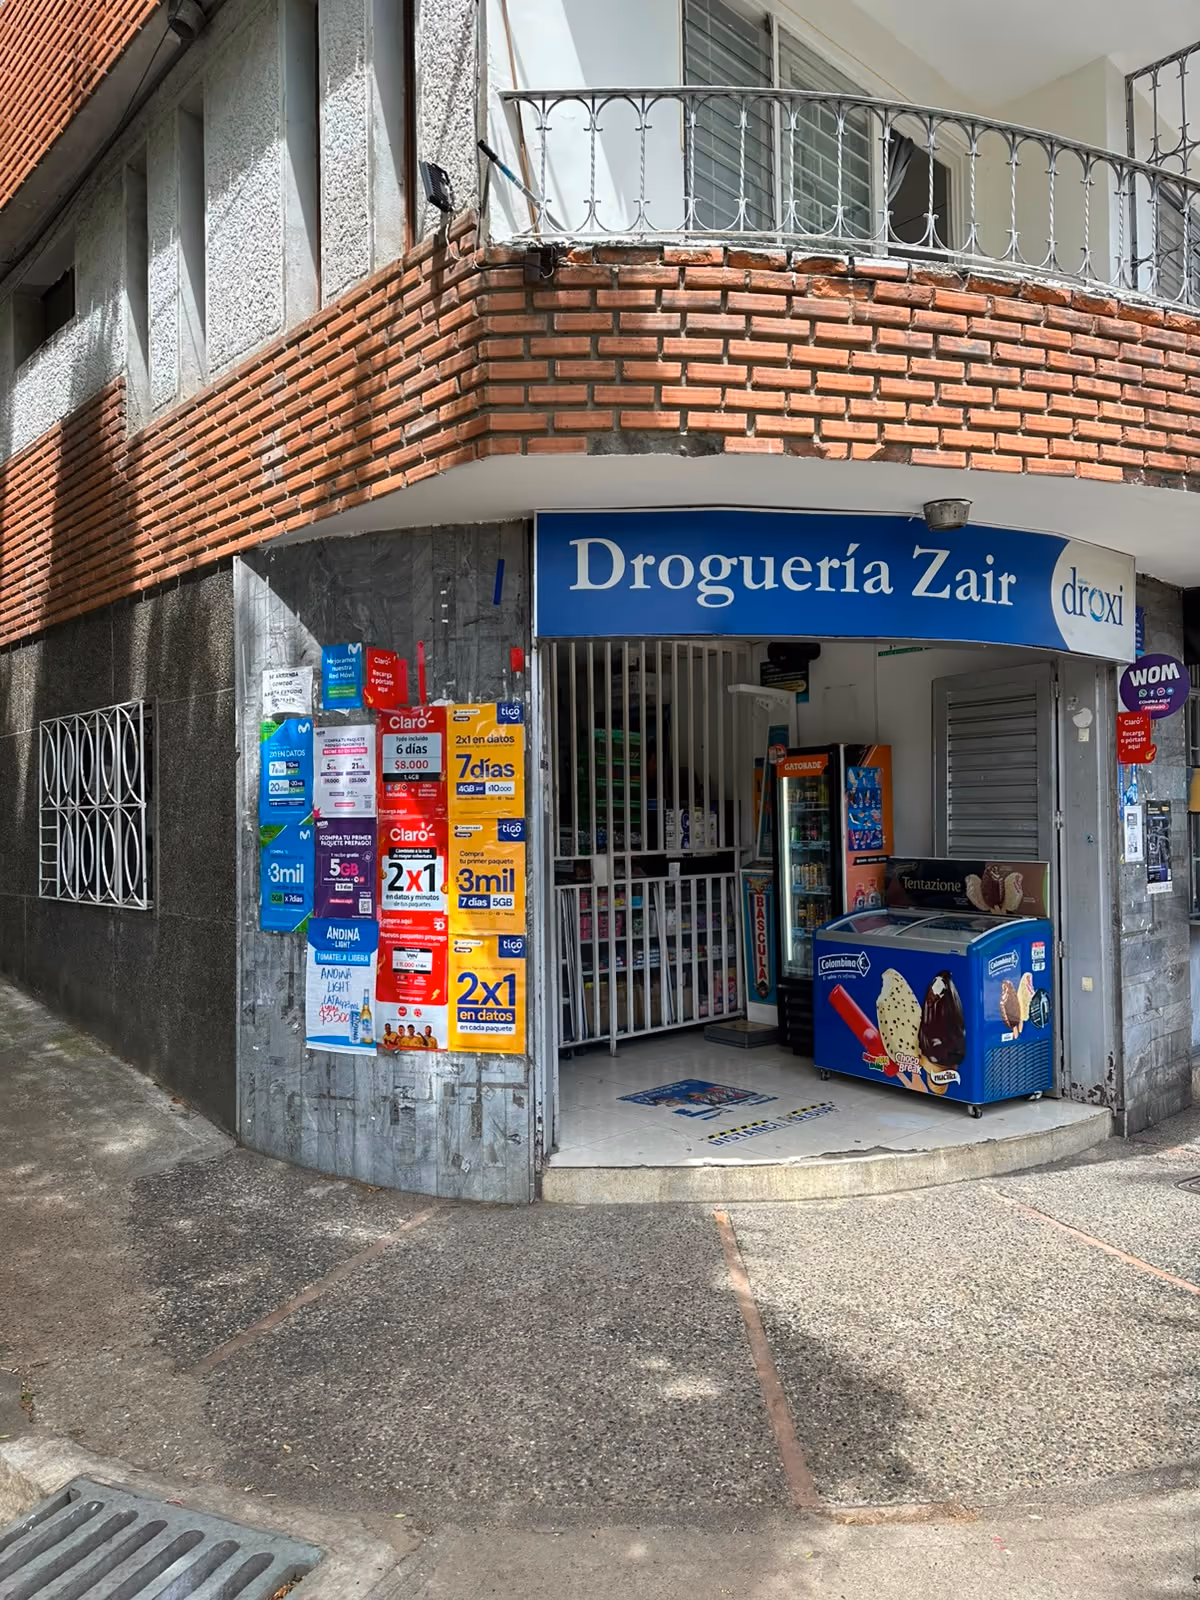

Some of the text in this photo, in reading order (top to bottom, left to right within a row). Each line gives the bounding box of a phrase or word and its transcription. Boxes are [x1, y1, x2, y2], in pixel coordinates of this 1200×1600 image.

[569, 536, 1018, 609] Droguería Zair
[1061, 566, 1124, 627] droxi
[327, 657, 356, 665] Mejoramos
[373, 656, 389, 665] Claro
[340, 671, 355, 679] Móvil
[372, 669, 393, 679] Recarga
[1129, 662, 1181, 687] WOM
[389, 711, 430, 730] Claro
[1123, 717, 1141, 726] Claro
[1122, 730, 1145, 738] Recarga
[455, 735, 471, 745] 2x1
[487, 735, 515, 744] datos
[1125, 736, 1147, 744] pórtate
[286, 749, 306, 757] DATOS
[396, 743, 428, 755] 6 días
[394, 759, 429, 770] $8.000
[784, 760, 822, 771] GATORADE
[458, 784, 475, 792] 4GB
[389, 826, 430, 841] Claro
[459, 850, 484, 859] Compra
[329, 858, 359, 877] 5GB
[467, 858, 487, 866] primer
[487, 858, 514, 866] paquete
[387, 862, 436, 892] 2x1
[901, 875, 962, 893] Tentazione
[460, 897, 488, 907] 7 días
[492, 897, 513, 907] 5GB
[326, 926, 361, 941] ANDINA
[756, 895, 768, 980] BASCULA
[334, 941, 351, 949] LIGHT
[347, 954, 369, 962] LIGERA
[821, 956, 857, 970] Colombina
[321, 967, 352, 980] ANDINA
[327, 980, 351, 993] LIGHT
[456, 972, 516, 1006] 2x1
[460, 1010, 513, 1021] en datos
[485, 1025, 513, 1033] paquete
[895, 1052, 920, 1065] Choco
[898, 1063, 922, 1075] Break
